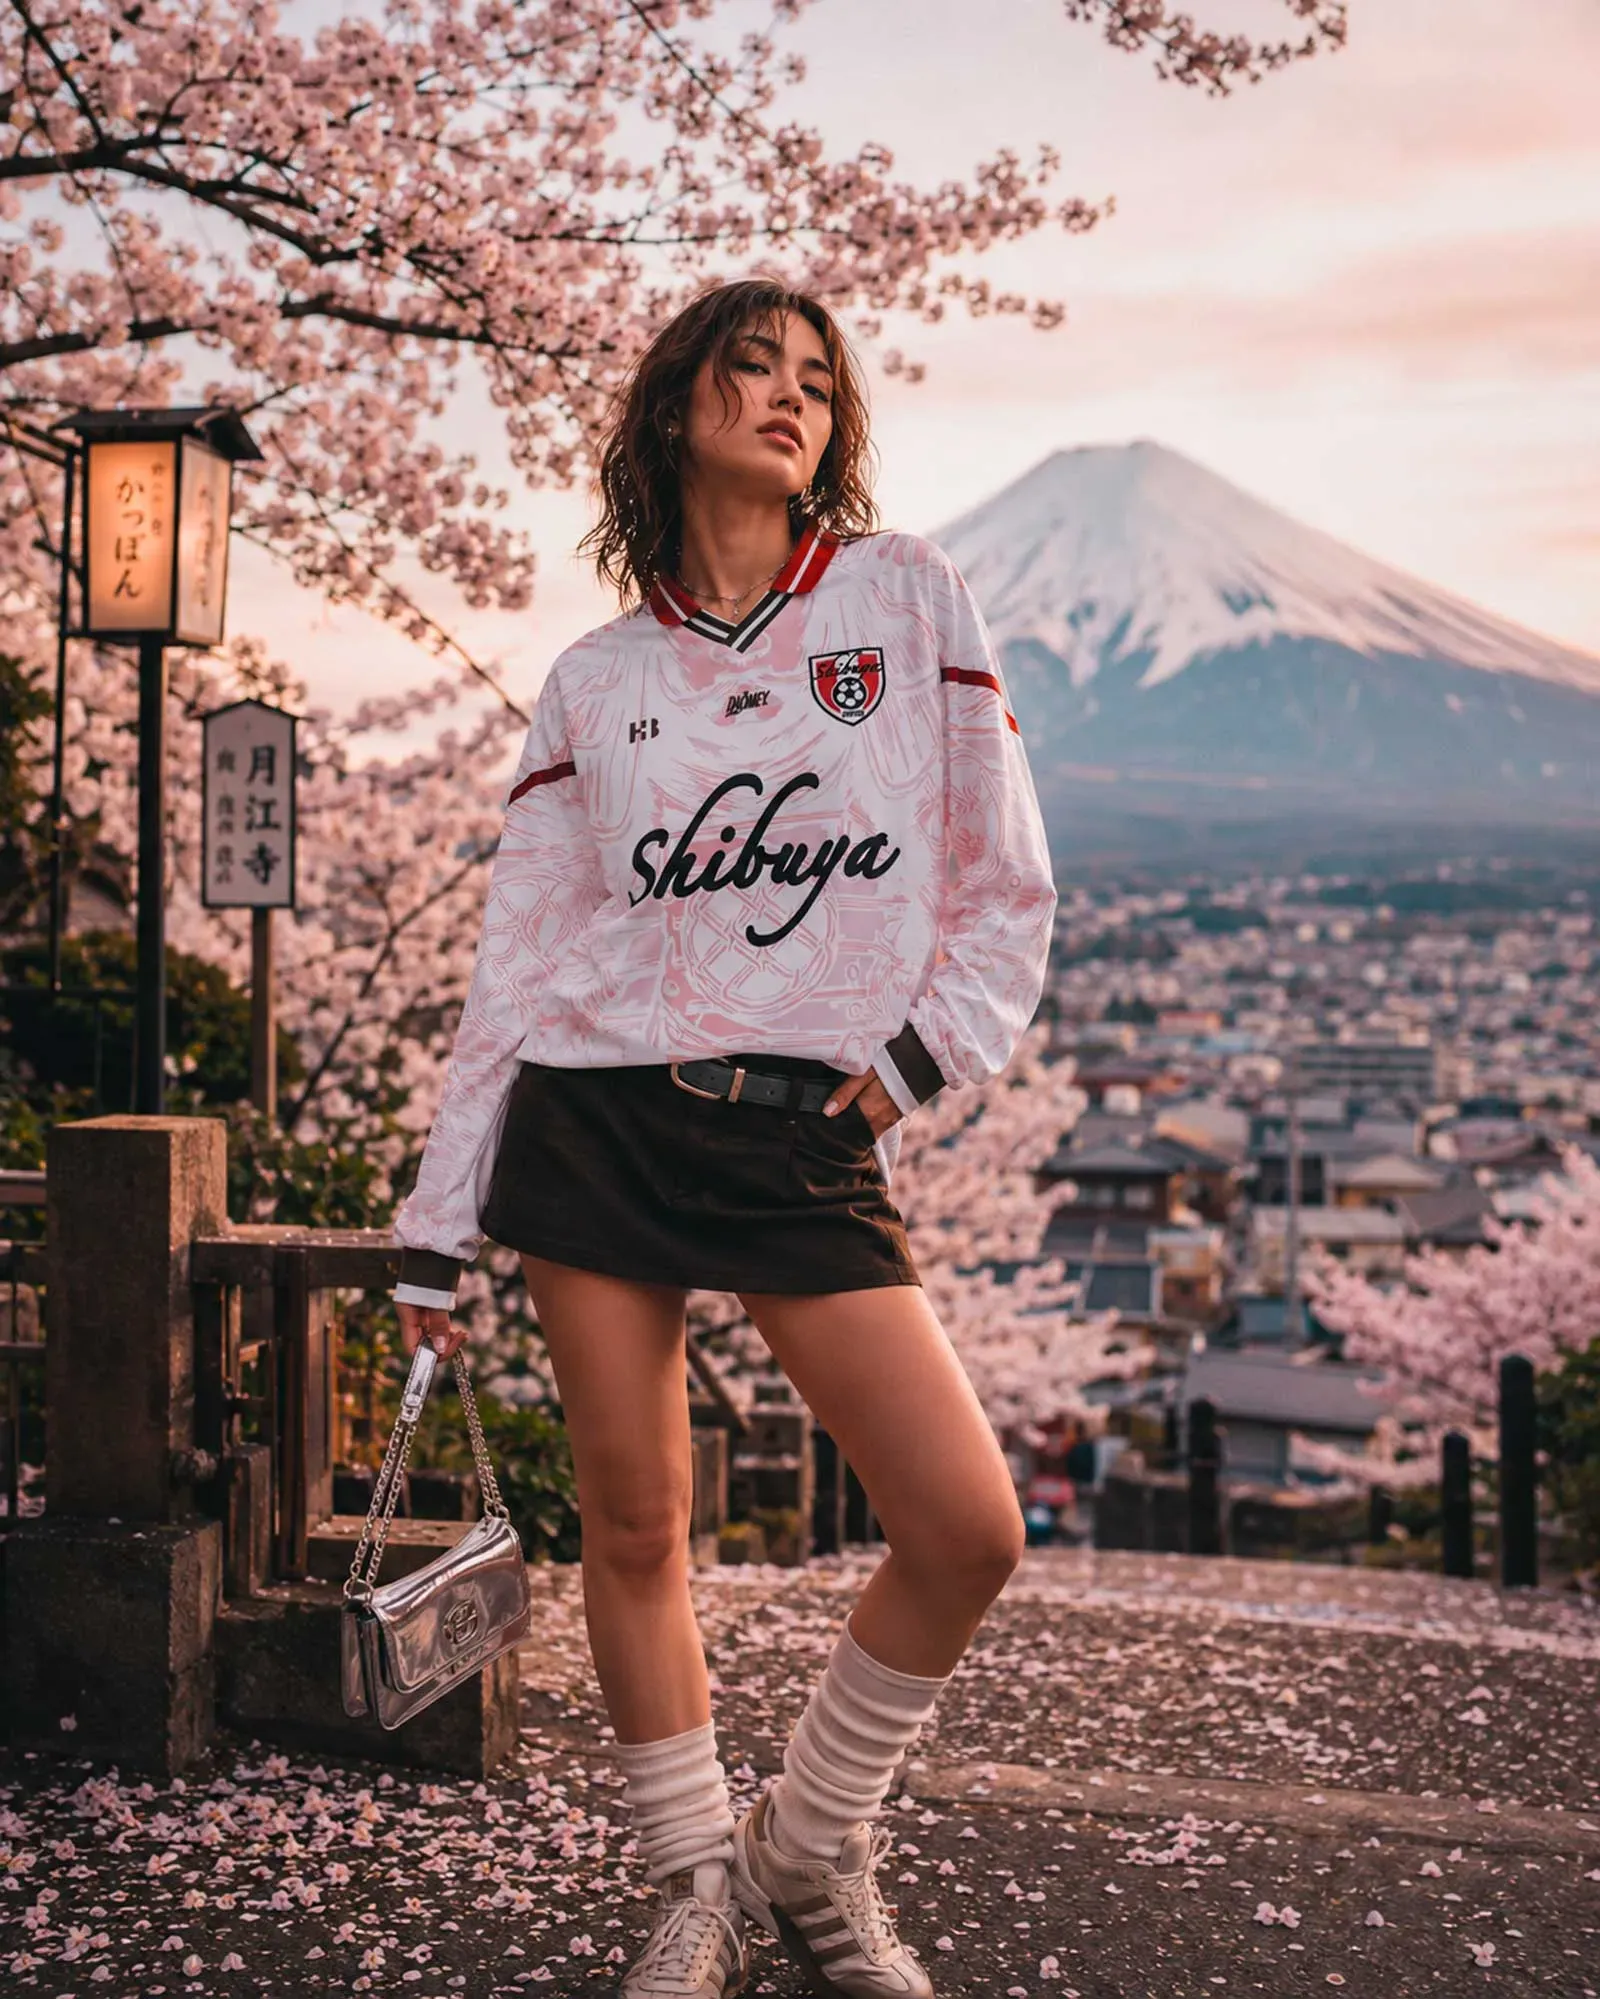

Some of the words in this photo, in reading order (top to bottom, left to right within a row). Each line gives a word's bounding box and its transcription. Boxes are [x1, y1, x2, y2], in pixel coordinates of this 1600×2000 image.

[245, 744, 281, 885] 月江寺
[628, 773, 900, 946] Shibuya
